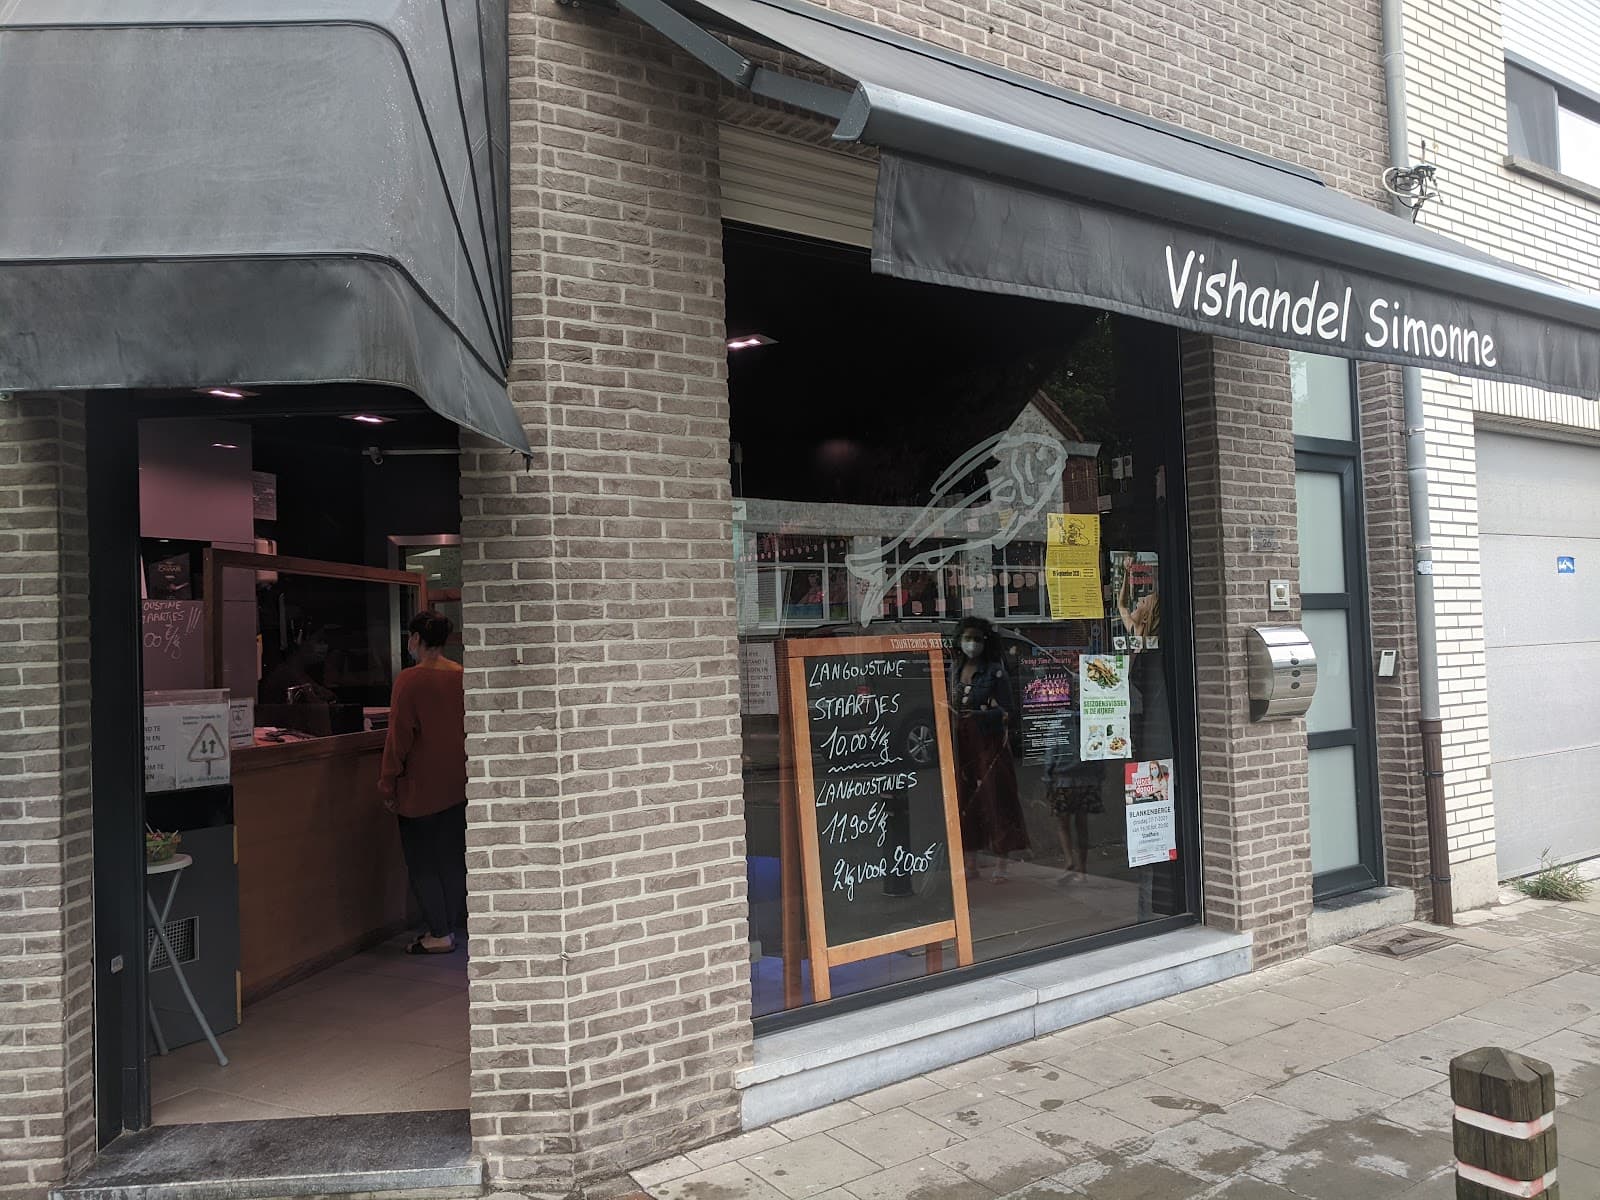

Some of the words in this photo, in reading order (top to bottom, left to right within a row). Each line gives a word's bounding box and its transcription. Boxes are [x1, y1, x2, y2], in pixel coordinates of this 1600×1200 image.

[1165, 245, 1352, 343] Vishandel
[1364, 298, 1497, 368] Simonne
[809, 659, 906, 687] LANGOUSTINE
[812, 693, 901, 725] STAARTJES
[815, 771, 918, 807] LANGOUSTINES
[1129, 806, 1172, 819] BLANKENBERGE
[857, 858, 887, 884] VOOR
